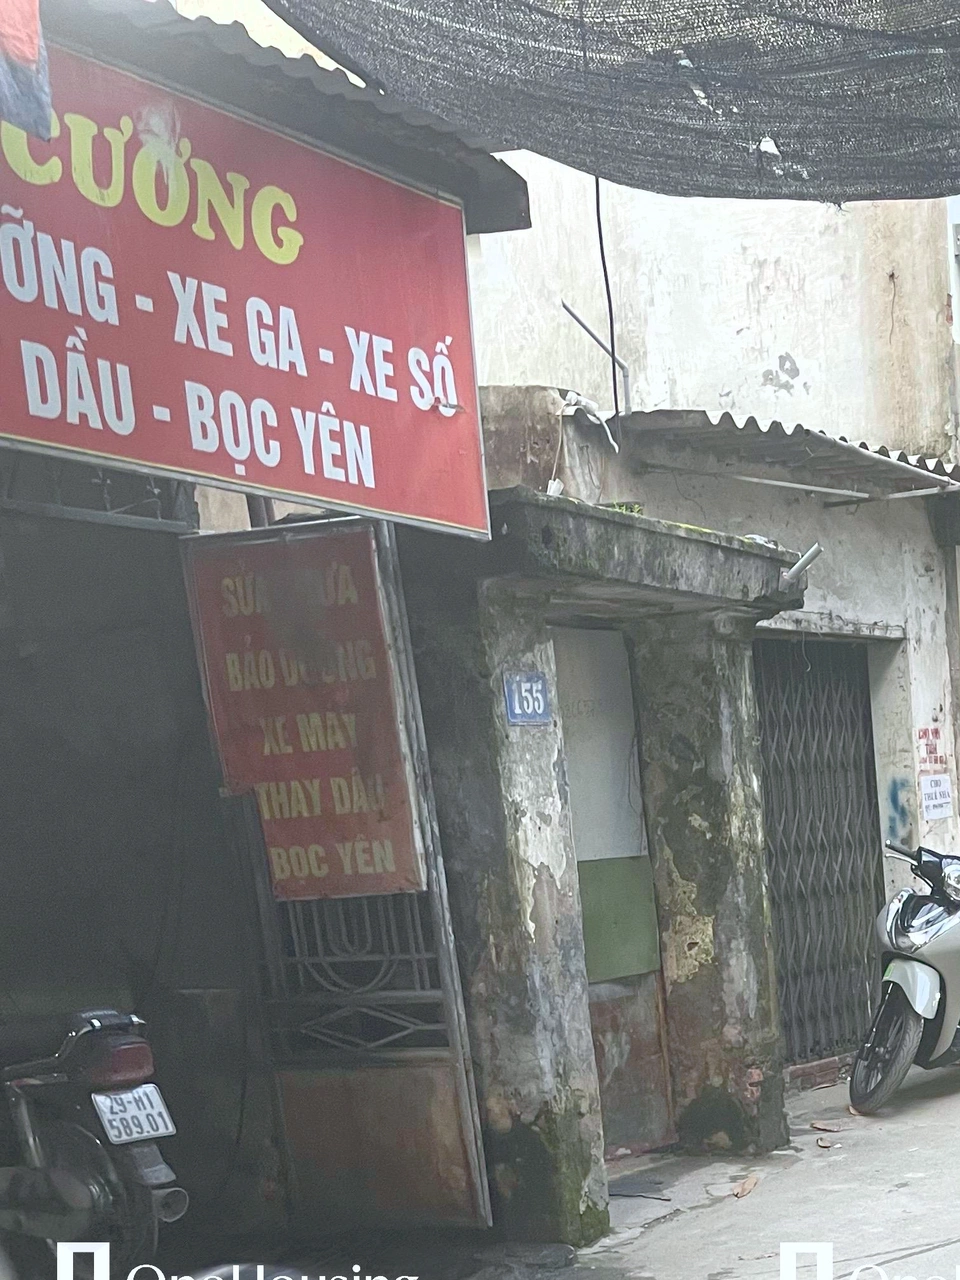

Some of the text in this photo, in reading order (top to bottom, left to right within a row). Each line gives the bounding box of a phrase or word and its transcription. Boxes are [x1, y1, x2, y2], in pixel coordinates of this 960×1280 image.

[166, 270, 234, 358] XE
[245, 296, 308, 378] GA
[344, 325, 398, 403] XE
[407, 335, 458, 418] SỐ
[20, 325, 136, 437] DẦU
[184, 379, 282, 476] BỌC
[290, 400, 376, 489] YÊN
[513, 676, 545, 715] 155
[254, 778, 322, 820] THAY
[336, 833, 396, 875] YÊN
[108, 1111, 170, 1139] 589.01
